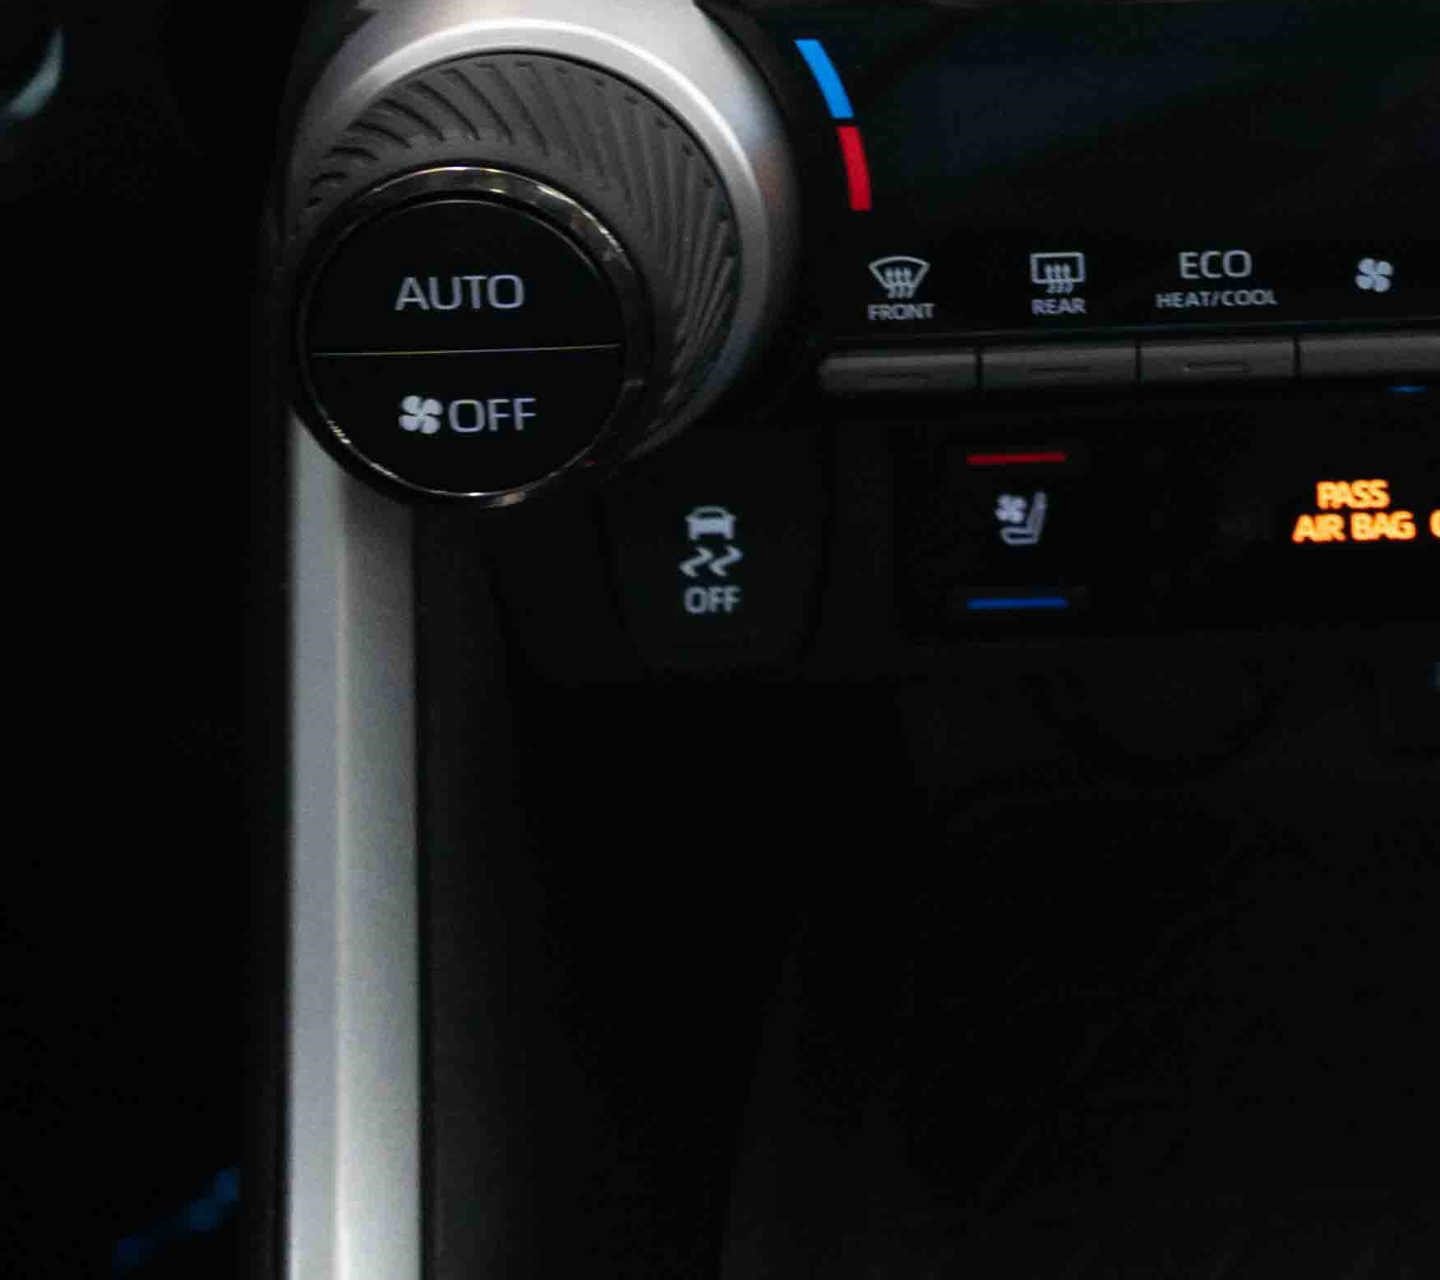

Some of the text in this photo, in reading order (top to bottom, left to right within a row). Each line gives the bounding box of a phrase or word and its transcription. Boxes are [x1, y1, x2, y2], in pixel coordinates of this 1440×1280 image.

[1178, 249, 1252, 280] ECO
[394, 274, 526, 312] AUTO
[1031, 297, 1087, 316] REAR
[1156, 287, 1278, 310] HEAT/COOL
[867, 302, 935, 322] FRONT
[448, 396, 538, 434] OFF
[1316, 479, 1391, 511] PASS
[1292, 513, 1346, 543] AIR
[1350, 510, 1417, 542] BAG
[684, 586, 742, 616] OFF
